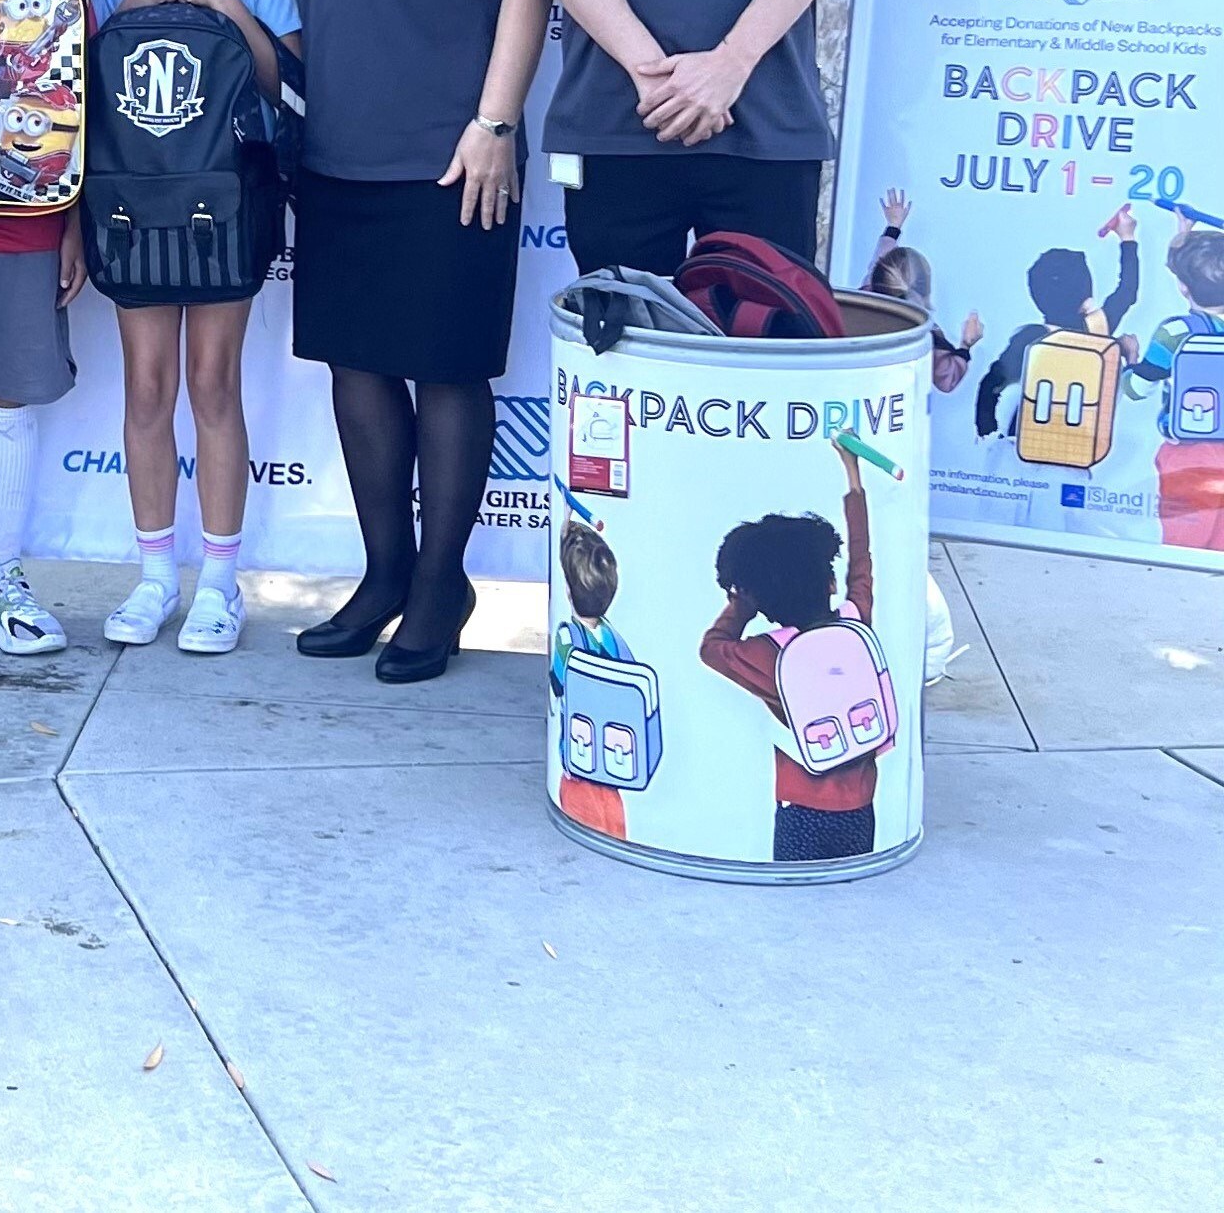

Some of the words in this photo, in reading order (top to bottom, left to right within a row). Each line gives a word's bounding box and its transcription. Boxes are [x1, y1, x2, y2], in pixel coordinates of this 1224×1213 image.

[929, 15, 1003, 31] Accepting
[1005, 17, 1080, 31] Donations
[1082, 20, 1099, 32] of
[1101, 20, 1134, 33] New
[1137, 21, 1222, 37] Backpacks
[941, 33, 961, 45] for
[964, 34, 1047, 51] Elementary
[1050, 37, 1061, 50] &
[1064, 37, 1115, 52] Middle
[1117, 39, 1170, 54] School
[1173, 42, 1208, 56] Kids
[146, 51, 177, 114] N
[942, 63, 1198, 110] BACKPACK
[996, 111, 1135, 153] DRIVE
[939, 153, 1050, 194] JULY
[1060, 159, 1077, 196] 1
[1127, 163, 1186, 202] 20
[786, 392, 904, 441] DRIVE
[249, 460, 313, 485] VES.
[948, 470, 1011, 486] information,
[1013, 477, 1049, 489] please
[1087, 486, 1143, 507] island
[476, 512, 522, 528] ATER
[528, 515, 551, 529] SA
[1116, 507, 1143, 516] union
